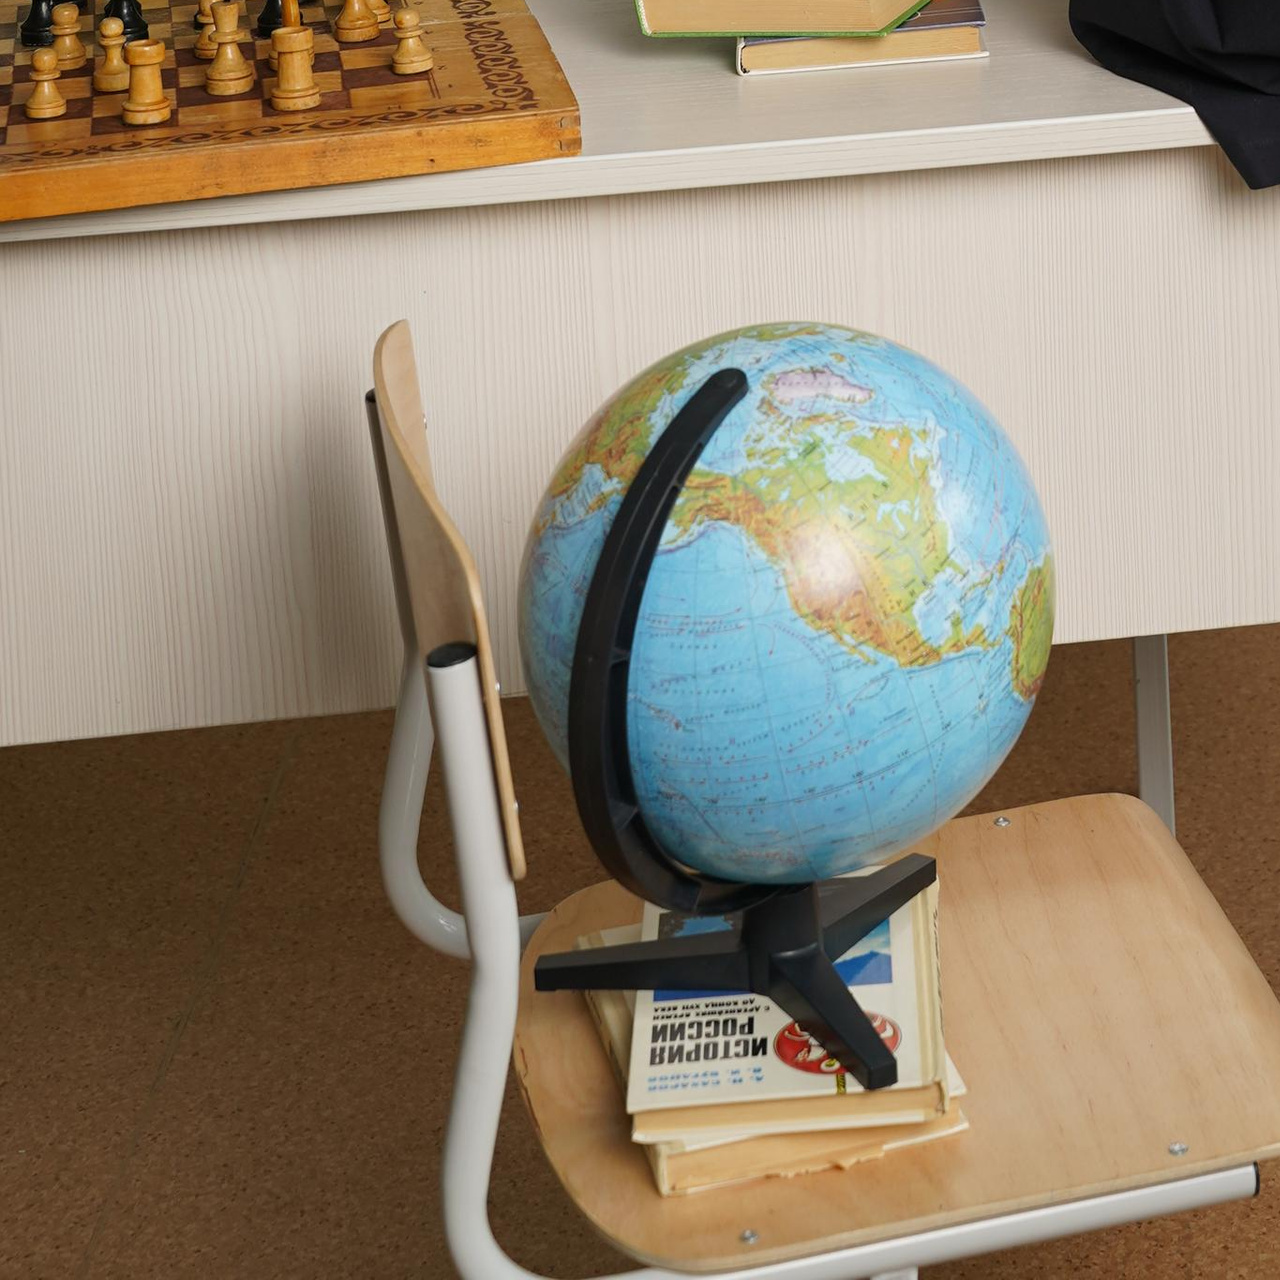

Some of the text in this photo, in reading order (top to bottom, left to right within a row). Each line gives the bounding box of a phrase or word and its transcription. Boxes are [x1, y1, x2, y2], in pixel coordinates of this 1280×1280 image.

[704, 999, 739, 1009] КОНЦА
[742, 998, 756, 1006] ДО
[653, 1005, 678, 1013] ВЕКА
[695, 1005, 761, 1017] ДРЕВНЕЙШИХ
[651, 1016, 755, 1044] РОССИИ
[649, 1037, 768, 1066] ИСТОРИЯ
